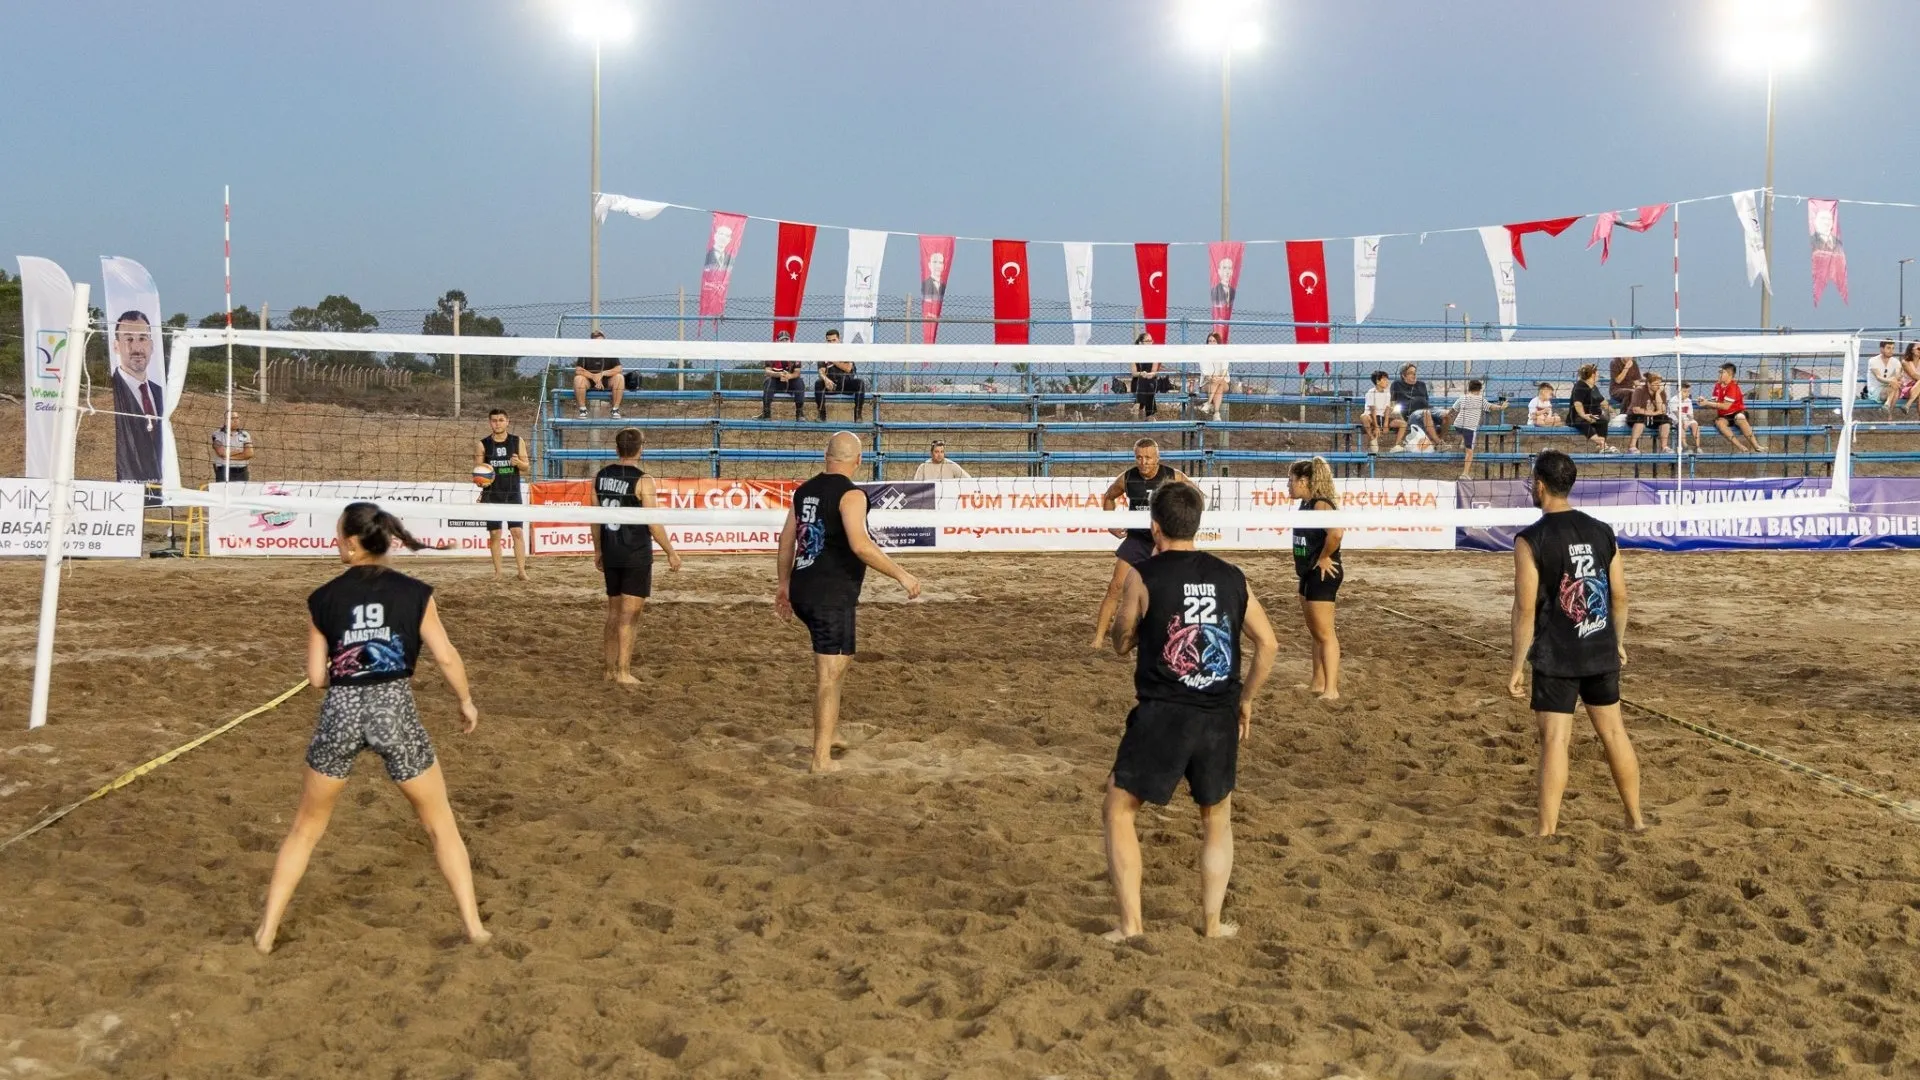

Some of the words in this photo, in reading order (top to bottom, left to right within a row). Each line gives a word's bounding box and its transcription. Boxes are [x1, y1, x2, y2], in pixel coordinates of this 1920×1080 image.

[0, 485, 125, 512] MİMRLIK
[704, 482, 769, 509] GÖK
[958, 491, 1002, 509] TÜM
[1251, 488, 1294, 506] TÜM
[1, 521, 88, 537] BAŞARAR
[92, 520, 136, 536] DİLER
[1613, 517, 1762, 537] PORCULARIMIZA
[1767, 516, 1872, 538] BAŞARILAR
[1877, 516, 1920, 536] DİLE
[74, 541, 85, 549] 79
[88, 542, 101, 550] 88
[218, 535, 251, 549] TÜM
[256, 537, 339, 549] SPORCULA
[540, 531, 573, 545] TÜM
[684, 532, 769, 546] BAŞARILAR
[1570, 555, 1596, 579] 72
[1183, 583, 1216, 597] ONUR
[352, 603, 384, 629] 19
[1183, 597, 1218, 624] 22
